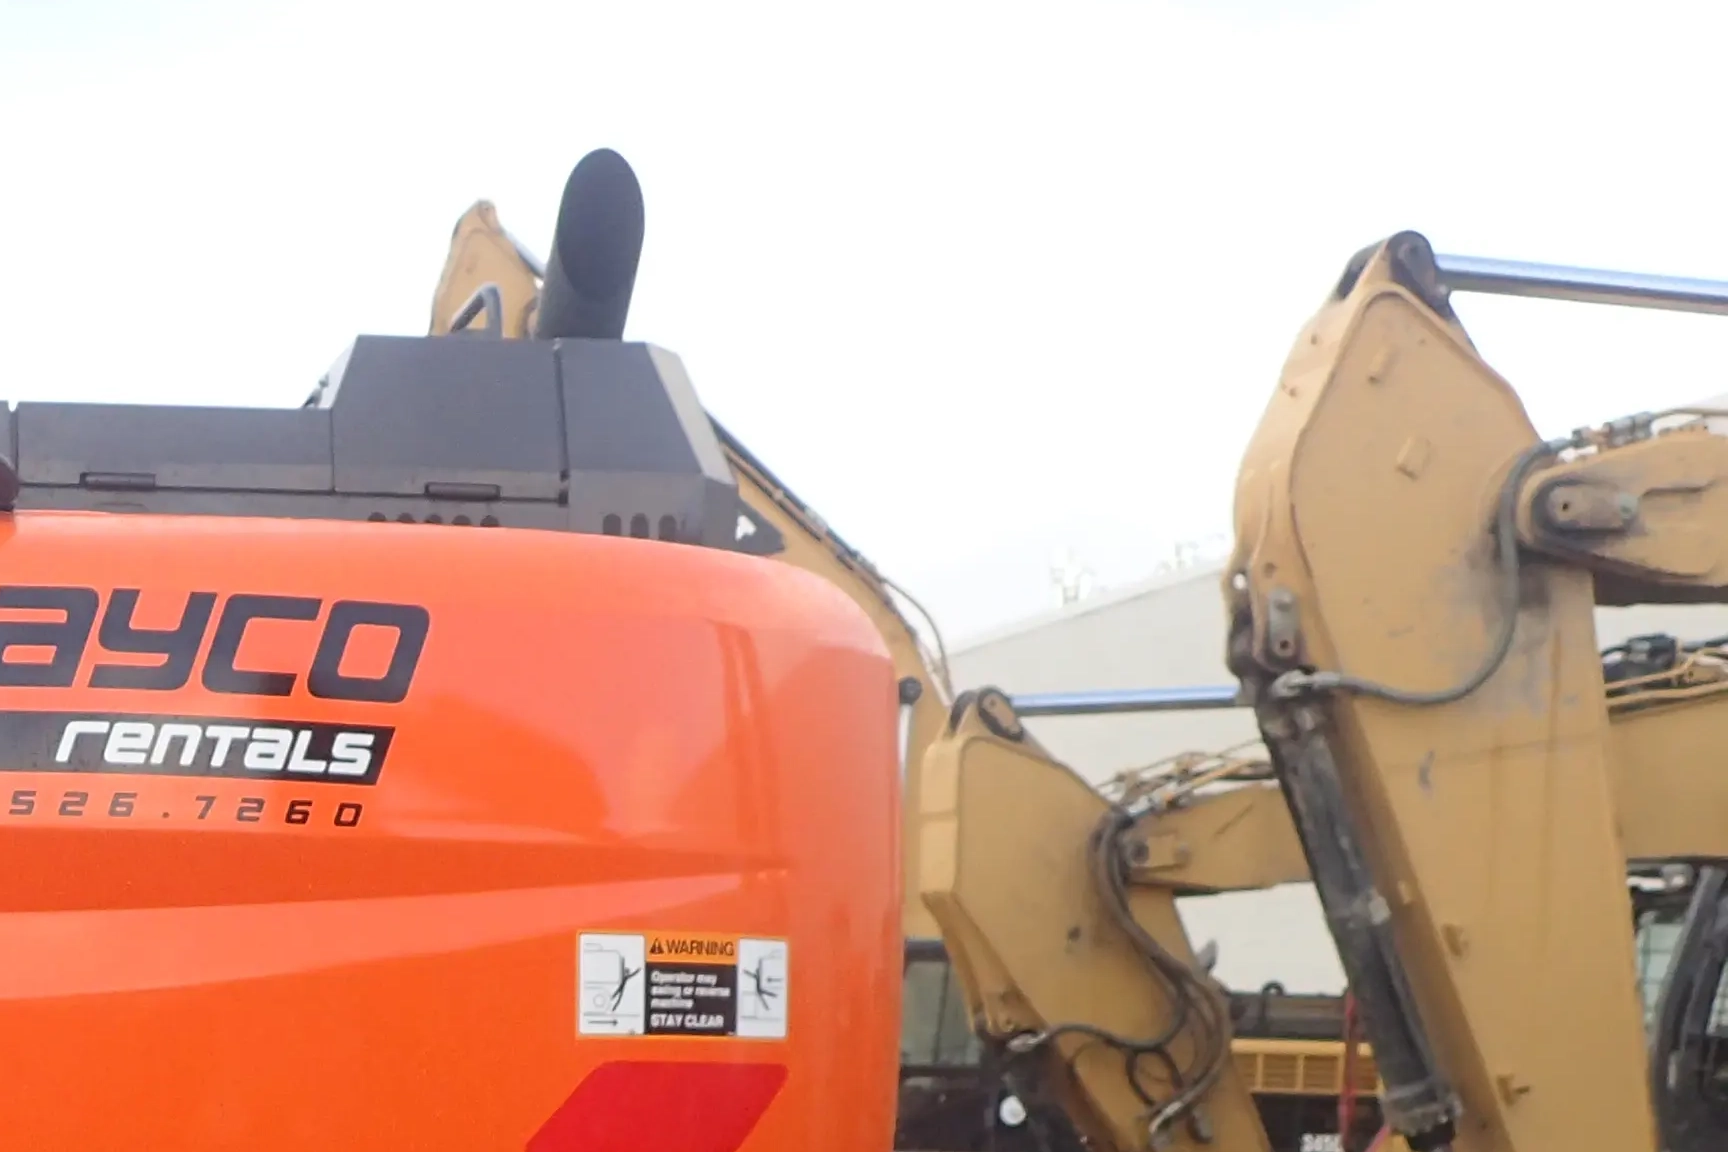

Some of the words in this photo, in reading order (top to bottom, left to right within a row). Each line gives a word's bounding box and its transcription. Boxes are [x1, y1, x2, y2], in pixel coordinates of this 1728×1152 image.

[667, 939, 734, 956] WARNING
[650, 1013, 683, 1028] STAY
[684, 1013, 724, 1029] CLEAR
